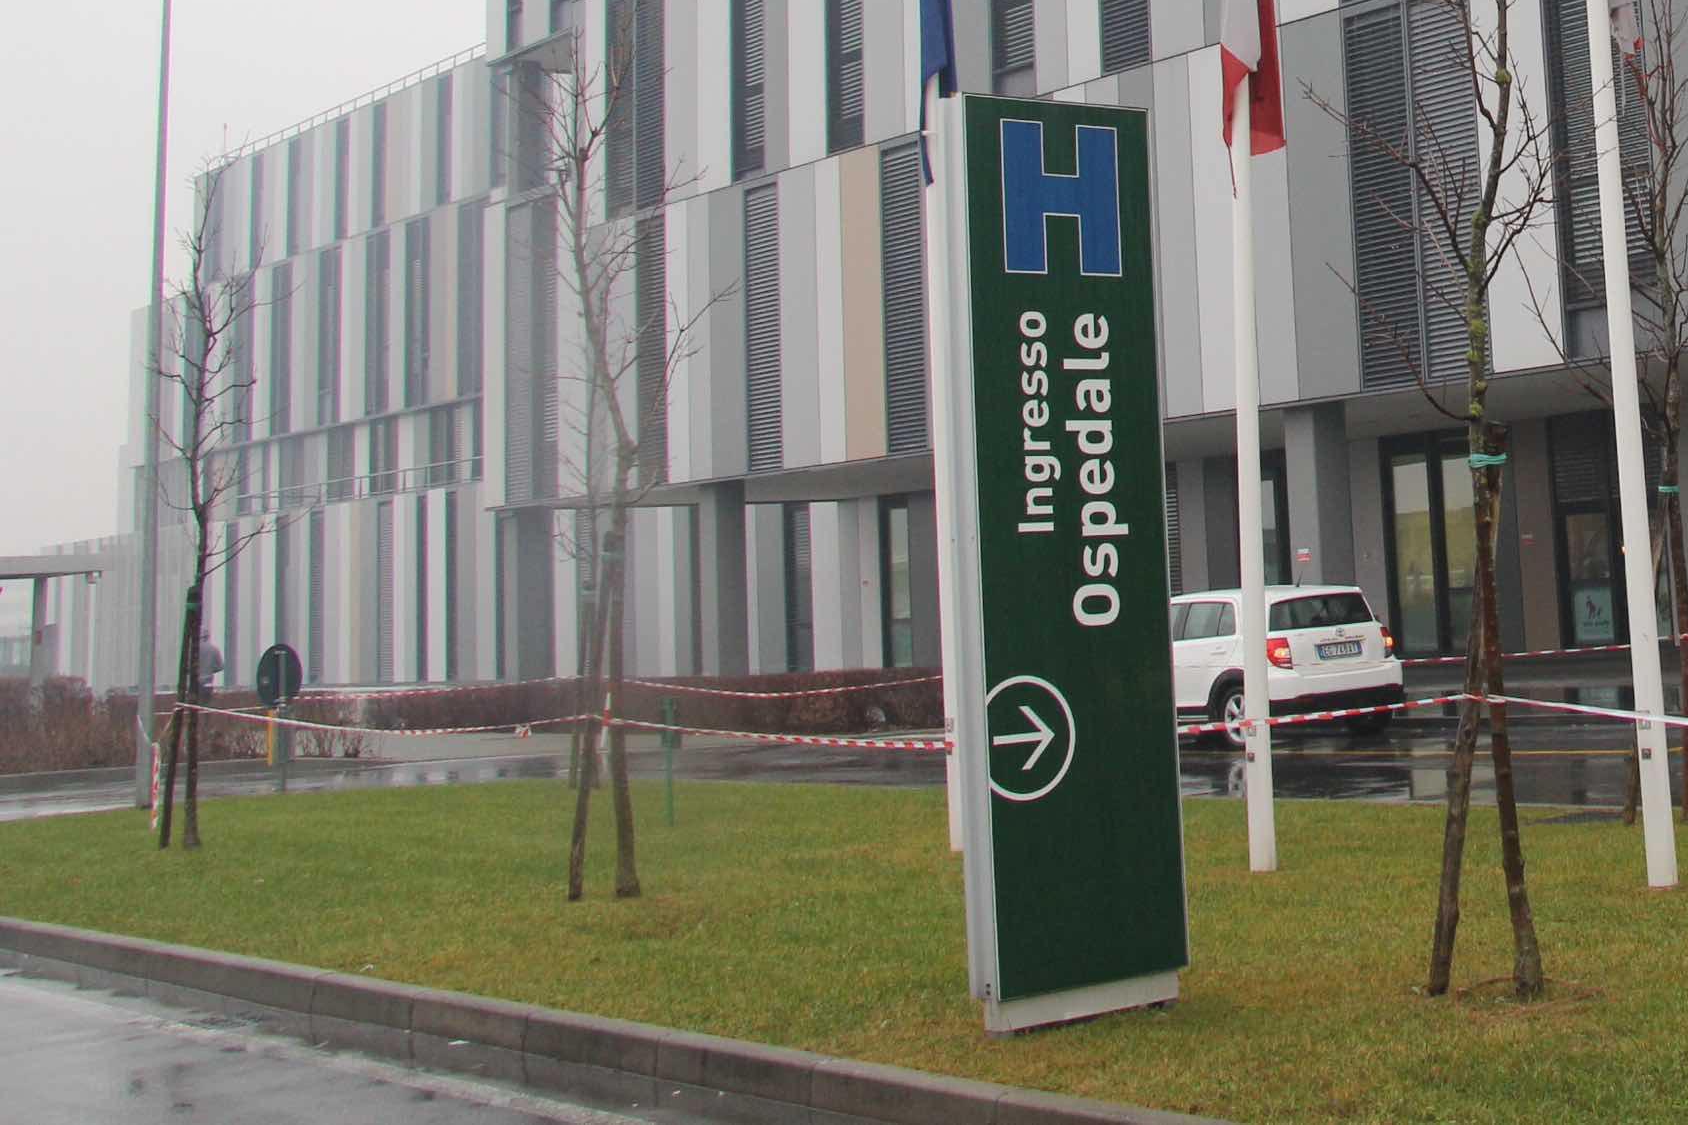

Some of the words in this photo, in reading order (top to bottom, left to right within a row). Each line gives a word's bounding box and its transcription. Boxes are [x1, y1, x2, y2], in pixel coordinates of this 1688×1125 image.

[999, 117, 1123, 278] H
[1017, 309, 1061, 534] Ingresso
[1063, 311, 1130, 629] Ospedale
